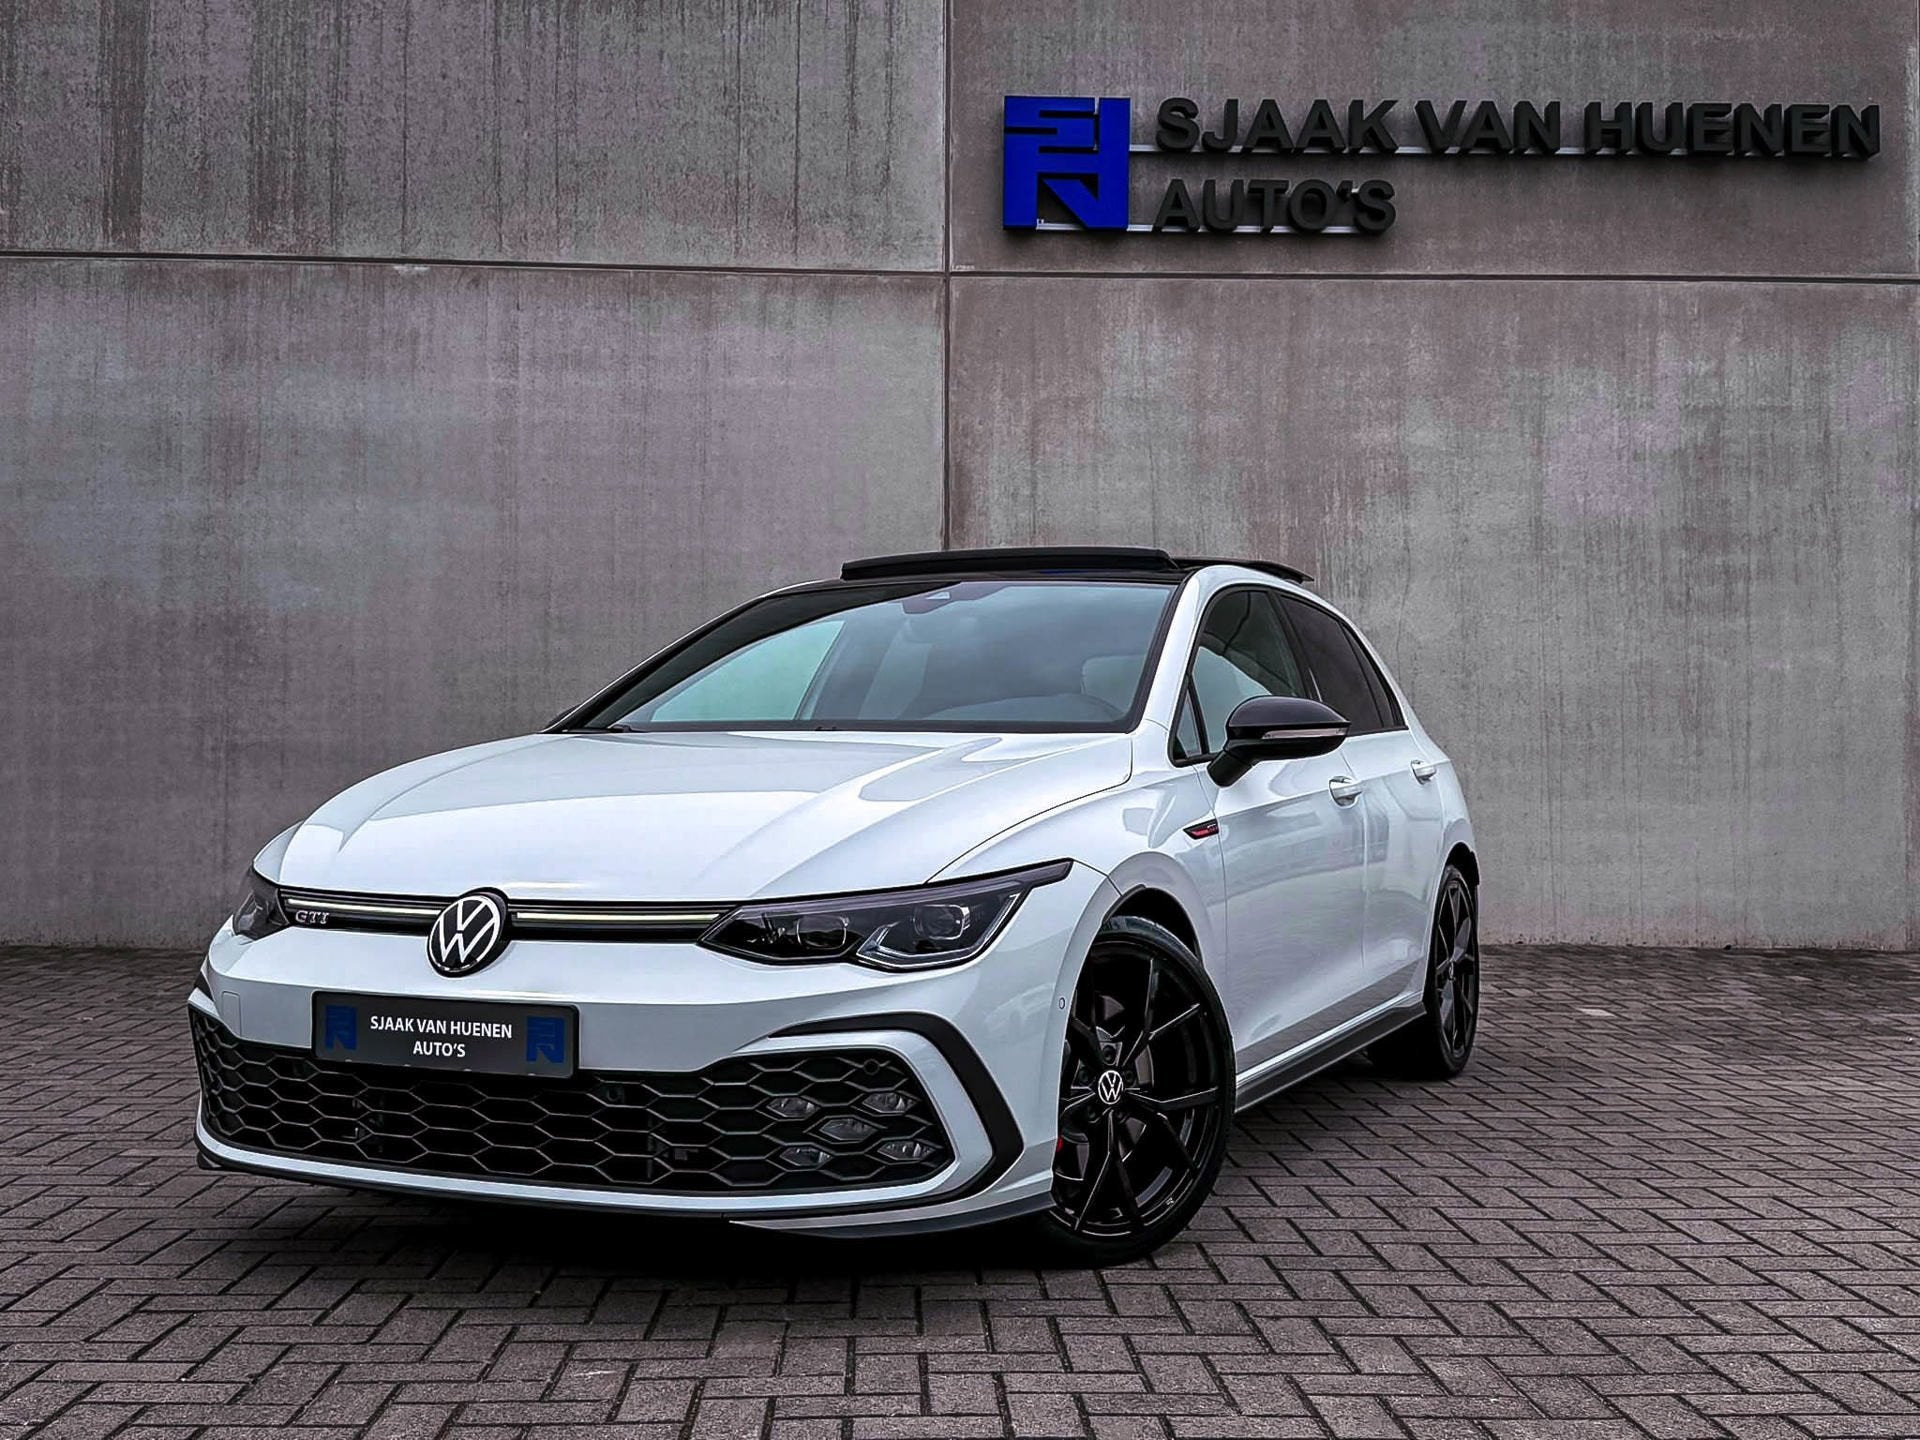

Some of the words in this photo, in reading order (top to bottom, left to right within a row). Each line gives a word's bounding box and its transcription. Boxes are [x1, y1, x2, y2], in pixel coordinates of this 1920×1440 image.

[1155, 97, 1399, 153] SJAAK
[1415, 99, 1560, 154] VAN
[1584, 101, 1880, 159] HUENEN
[1152, 178, 1396, 236] AUTO'S
[295, 910, 330, 924] GTI
[370, 1015, 414, 1033] SJAAK
[417, 1018, 447, 1035] VAN
[450, 1020, 512, 1039] HUENEN
[413, 1041, 466, 1057] AUTO'S
